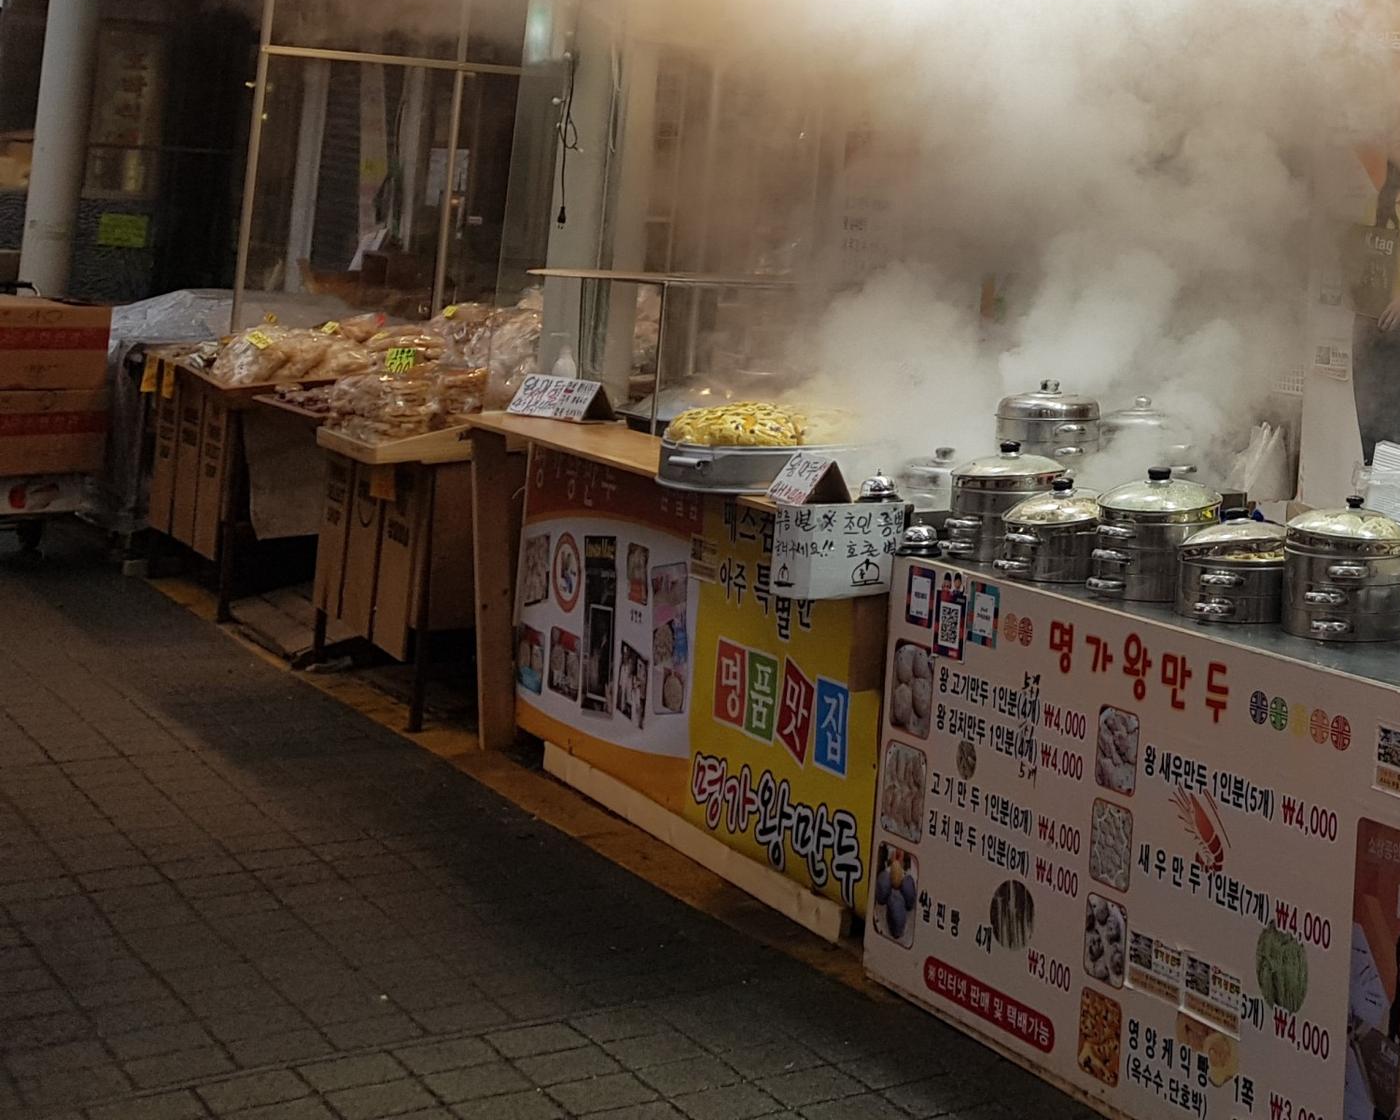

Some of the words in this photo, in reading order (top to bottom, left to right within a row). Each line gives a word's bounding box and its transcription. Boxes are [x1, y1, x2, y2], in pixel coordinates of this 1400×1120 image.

[719, 558, 747, 605] 아주
[938, 665, 951, 693] 왕
[950, 671, 990, 712] 고기만두
[1043, 703, 1087, 742] ₩4,000
[1049, 620, 1229, 724] 명가왕만두
[718, 648, 846, 776] 명품맛집
[935, 703, 947, 730] 왕
[948, 710, 988, 749] 김치만두
[1040, 742, 1084, 781] ₩4,000
[691, 752, 863, 908] 명가왕만두
[984, 792, 1033, 836] 1인분(8개)
[1037, 813, 1081, 856] ₩4,000
[1143, 743, 1157, 776] 왕
[1158, 752, 1208, 797] 새우만두
[1211, 770, 1275, 822] 1인분(5개)
[1281, 795, 1338, 842] ₩4,000
[981, 832, 1030, 878] 1인분(8개)
[1035, 855, 1078, 898] ₩4,000
[1206, 869, 1270, 923] 1인분(7개)
[1274, 894, 1332, 950] ₩4,000
[975, 923, 992, 955] 4개
[1027, 947, 1071, 993] ₩3,000
[969, 983, 991, 1016] 판매
[993, 997, 1004, 1021] 및
[1006, 1003, 1051, 1048] 택배가능
[1273, 1007, 1330, 1062] ₩4,000
